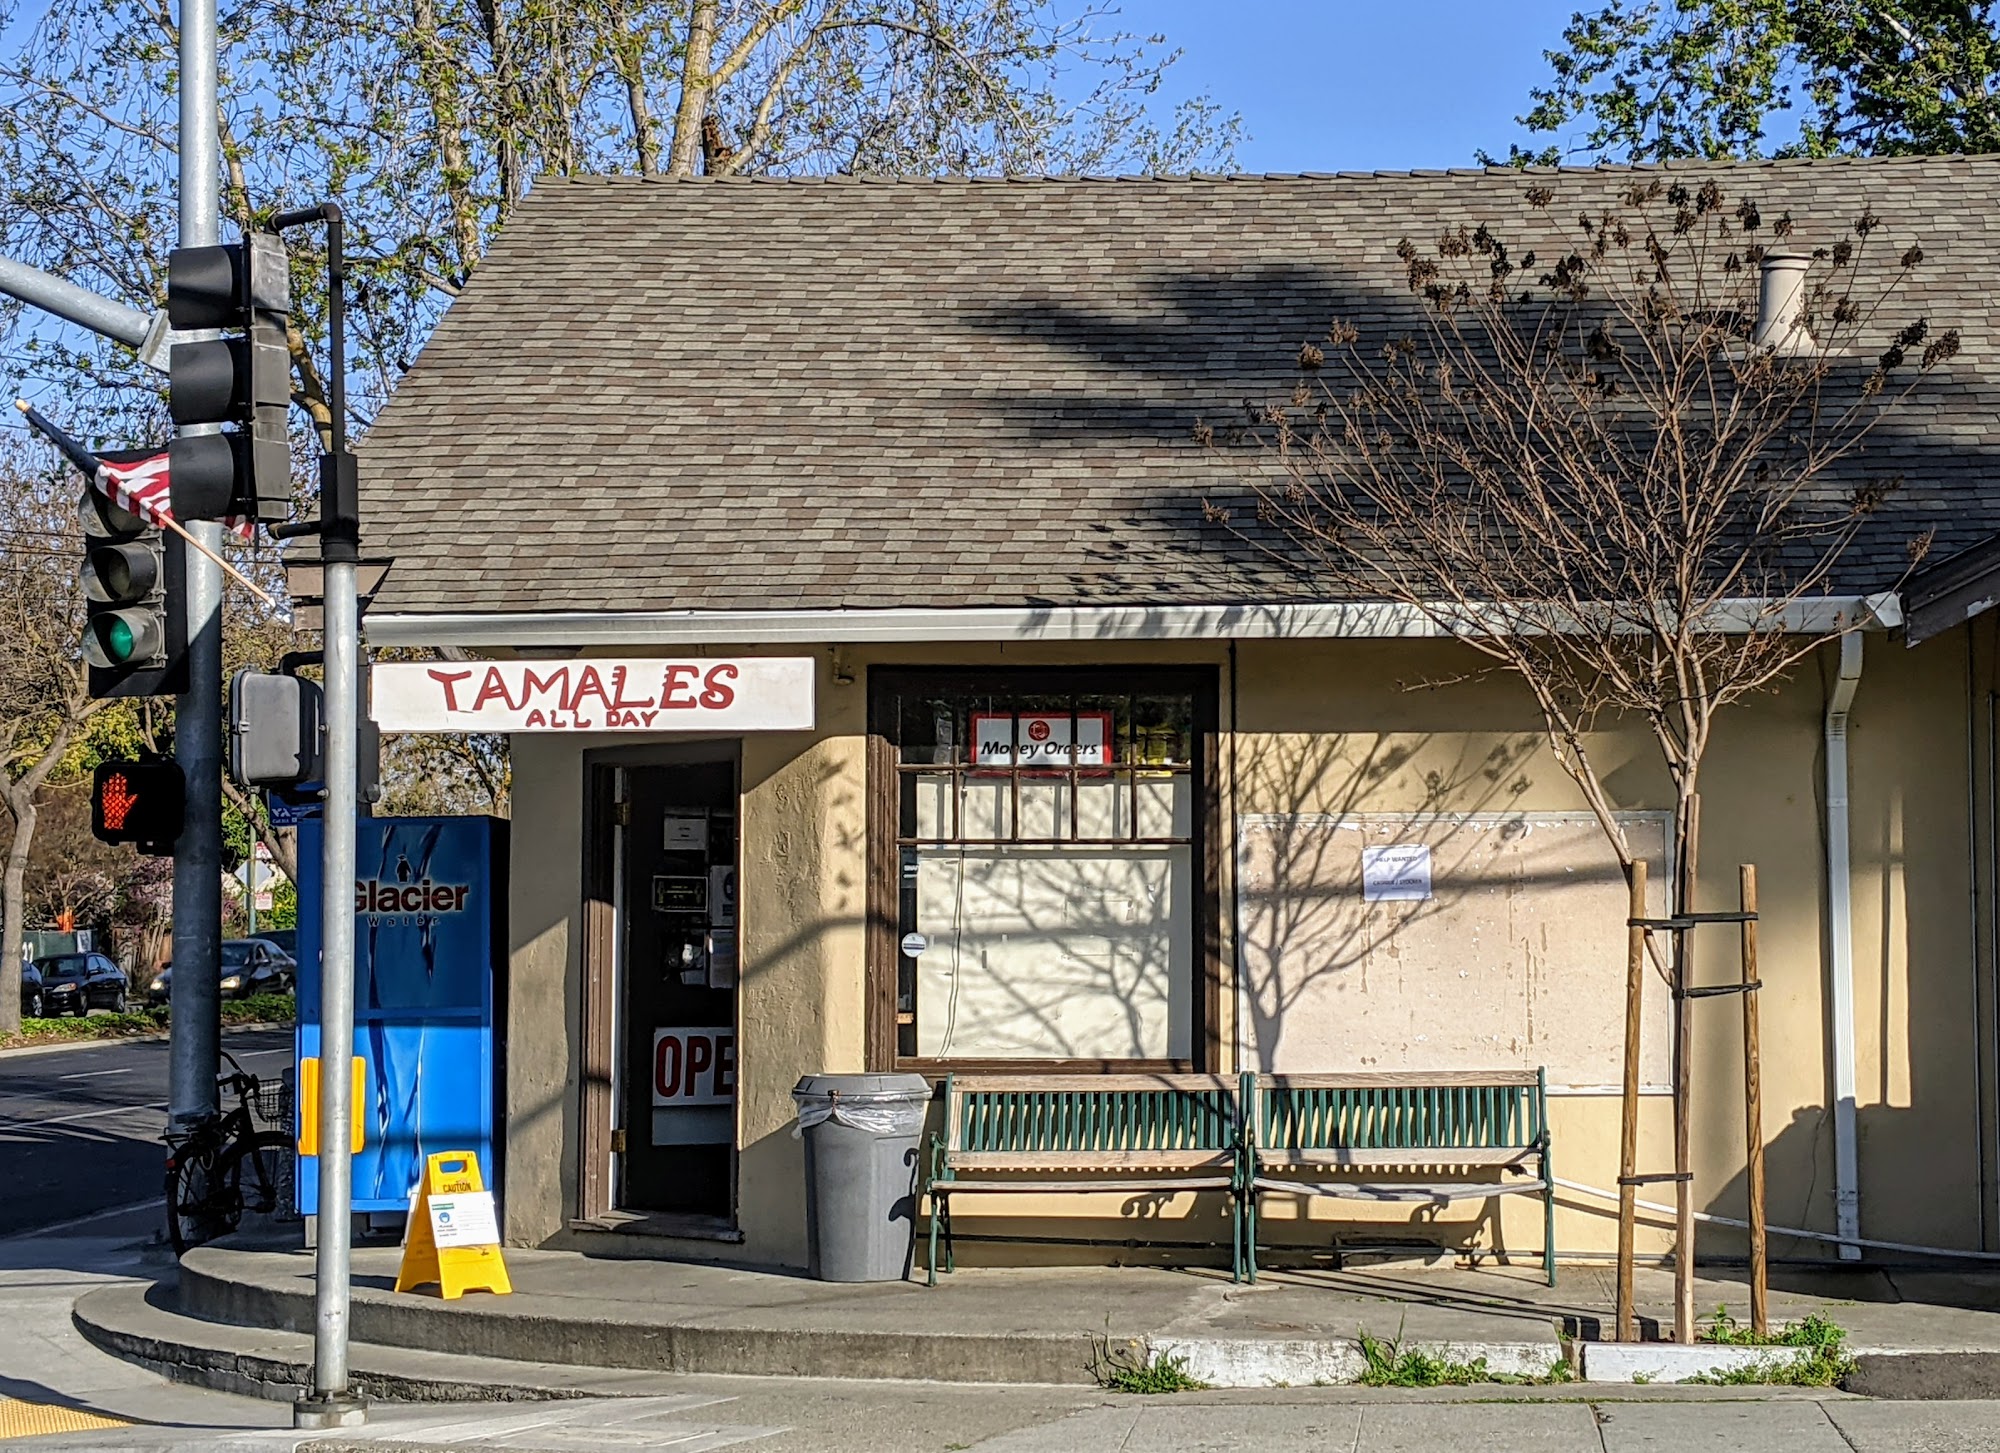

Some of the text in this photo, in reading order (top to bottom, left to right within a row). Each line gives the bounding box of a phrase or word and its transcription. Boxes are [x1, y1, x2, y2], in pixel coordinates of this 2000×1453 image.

[427, 664, 738, 711] TAMALES
[525, 708, 660, 728] ALL DAY
[980, 741, 1040, 760] Moey
[367, 916, 440, 927] Water
[443, 1182, 472, 1193] CAUTION
